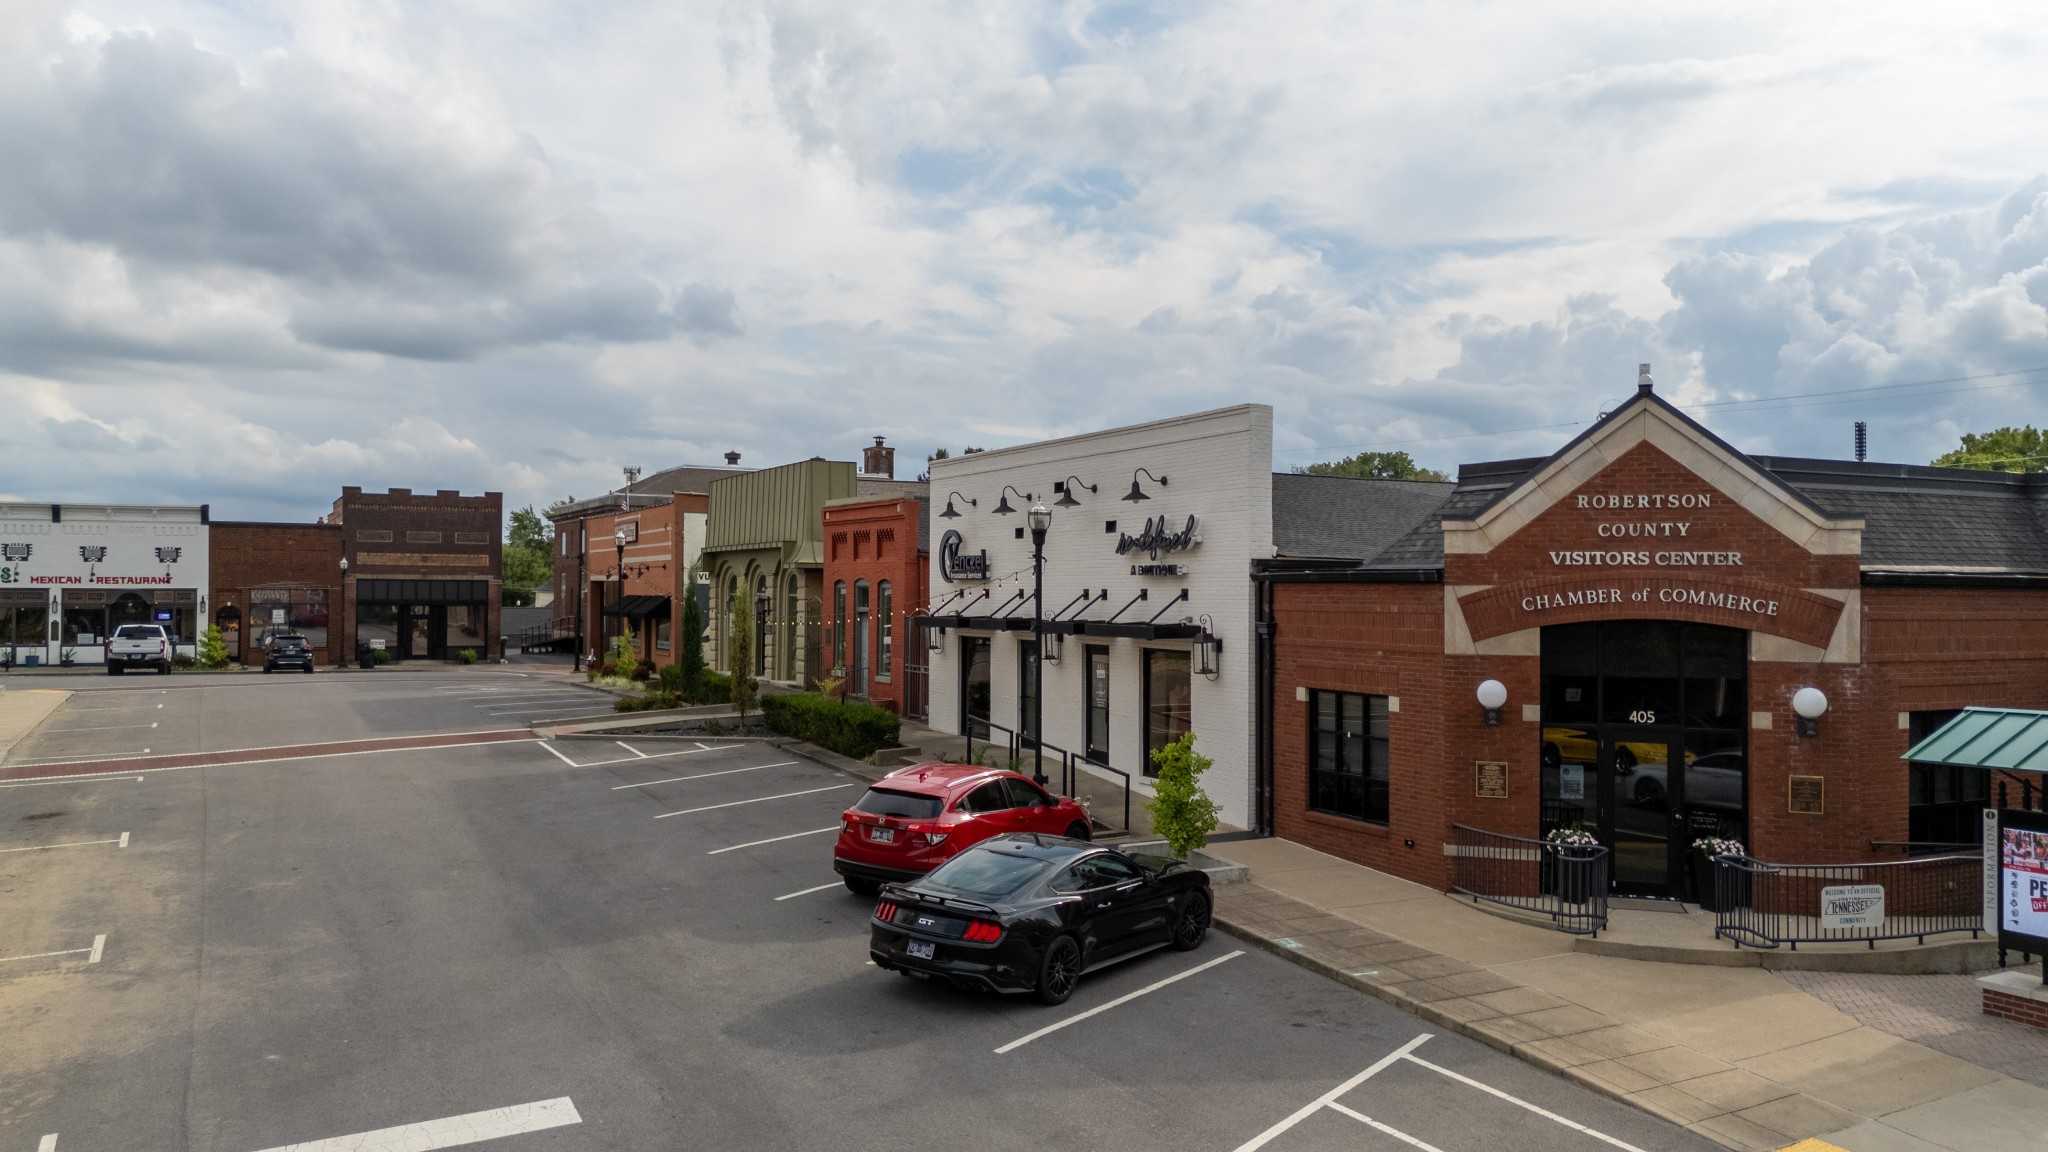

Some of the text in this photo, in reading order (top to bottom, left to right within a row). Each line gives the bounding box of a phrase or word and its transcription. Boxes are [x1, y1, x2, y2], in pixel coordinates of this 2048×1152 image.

[1577, 494, 1711, 509] ROBERTSON
[1597, 523, 1691, 537] COUNTY
[1549, 551, 1744, 566] VISITORS CENTER
[1130, 564, 1178, 576] A BOUTIQUE
[30, 576, 173, 585] MEXICAN RESTAURANT
[1522, 587, 1779, 616] CHAMBER of COMMERCE
[1629, 710, 1656, 724] 405
[1986, 824, 1995, 910] INFORMATION
[1830, 900, 1870, 914] TENNESSEE
[918, 917, 935, 926] GT
